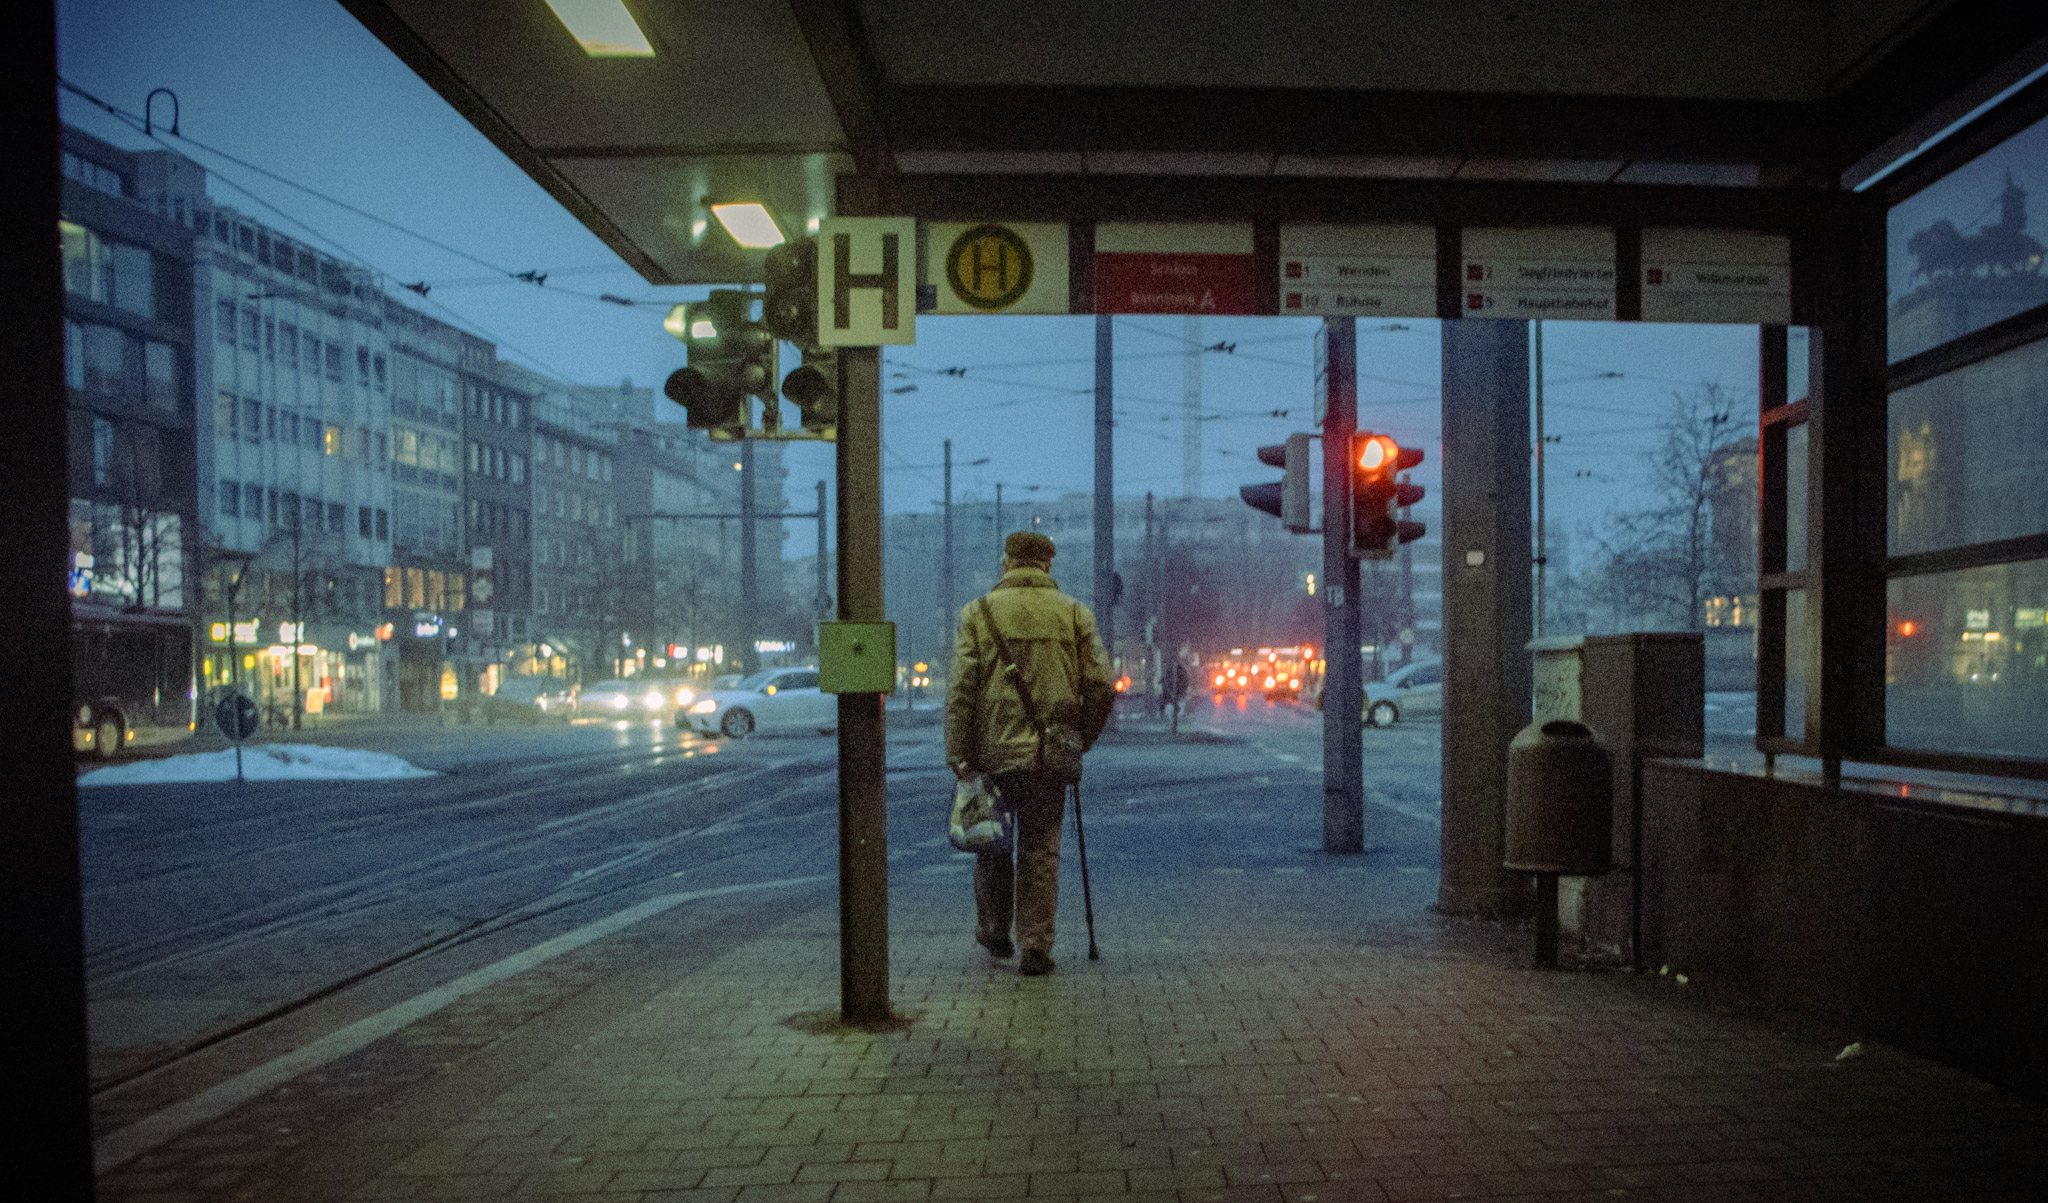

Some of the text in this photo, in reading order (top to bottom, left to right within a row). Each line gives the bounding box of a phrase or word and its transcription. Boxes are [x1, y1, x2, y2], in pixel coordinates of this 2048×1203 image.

[972, 239, 1008, 291] H
[1337, 265, 1392, 277] Wenden
[833, 233, 899, 329] H
[1199, 288, 1217, 309] A
[1304, 295, 1320, 307] 10
[1517, 296, 1609, 310] Hauptbahnhof
